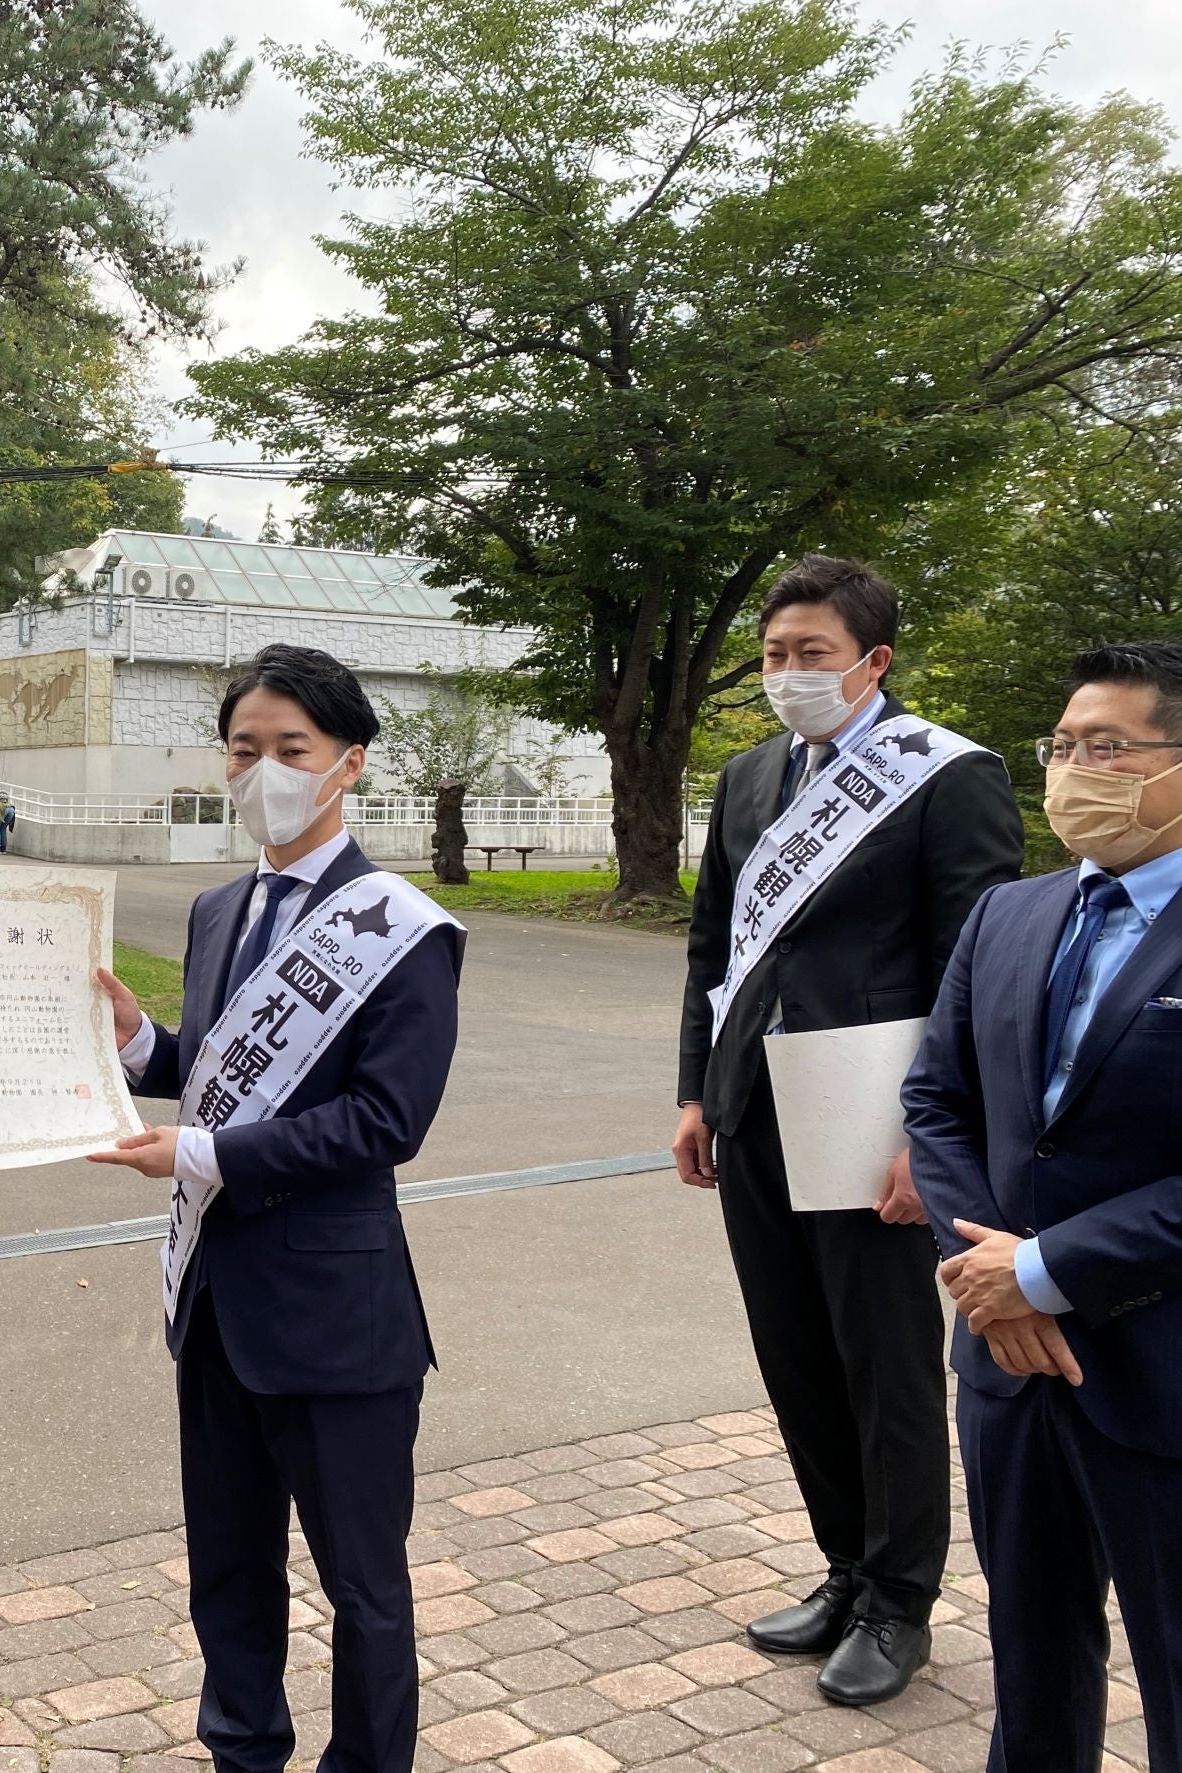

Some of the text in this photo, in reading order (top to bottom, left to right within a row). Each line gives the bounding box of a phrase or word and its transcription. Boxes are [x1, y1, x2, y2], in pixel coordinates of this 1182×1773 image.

[842, 771, 876, 806] NDA
[344, 877, 367, 892] sapporo
[316, 894, 340, 913] sapporo
[293, 914, 315, 936] sapporo
[270, 938, 291, 960] sapporo
[382, 944, 404, 968] sapporo
[248, 962, 269, 985] sapporo
[286, 959, 329, 1003] NDA
[358, 972, 378, 996] sapporo
[228, 988, 246, 1012] sapporo
[335, 998, 356, 1021] sapporo
[210, 1014, 228, 1038] sapporo
[313, 1026, 334, 1050] sapporo
[194, 991, 299, 1133] 札幌観
[294, 1052, 313, 1076] sapporo
[271, 1080, 292, 1102] sapporo
